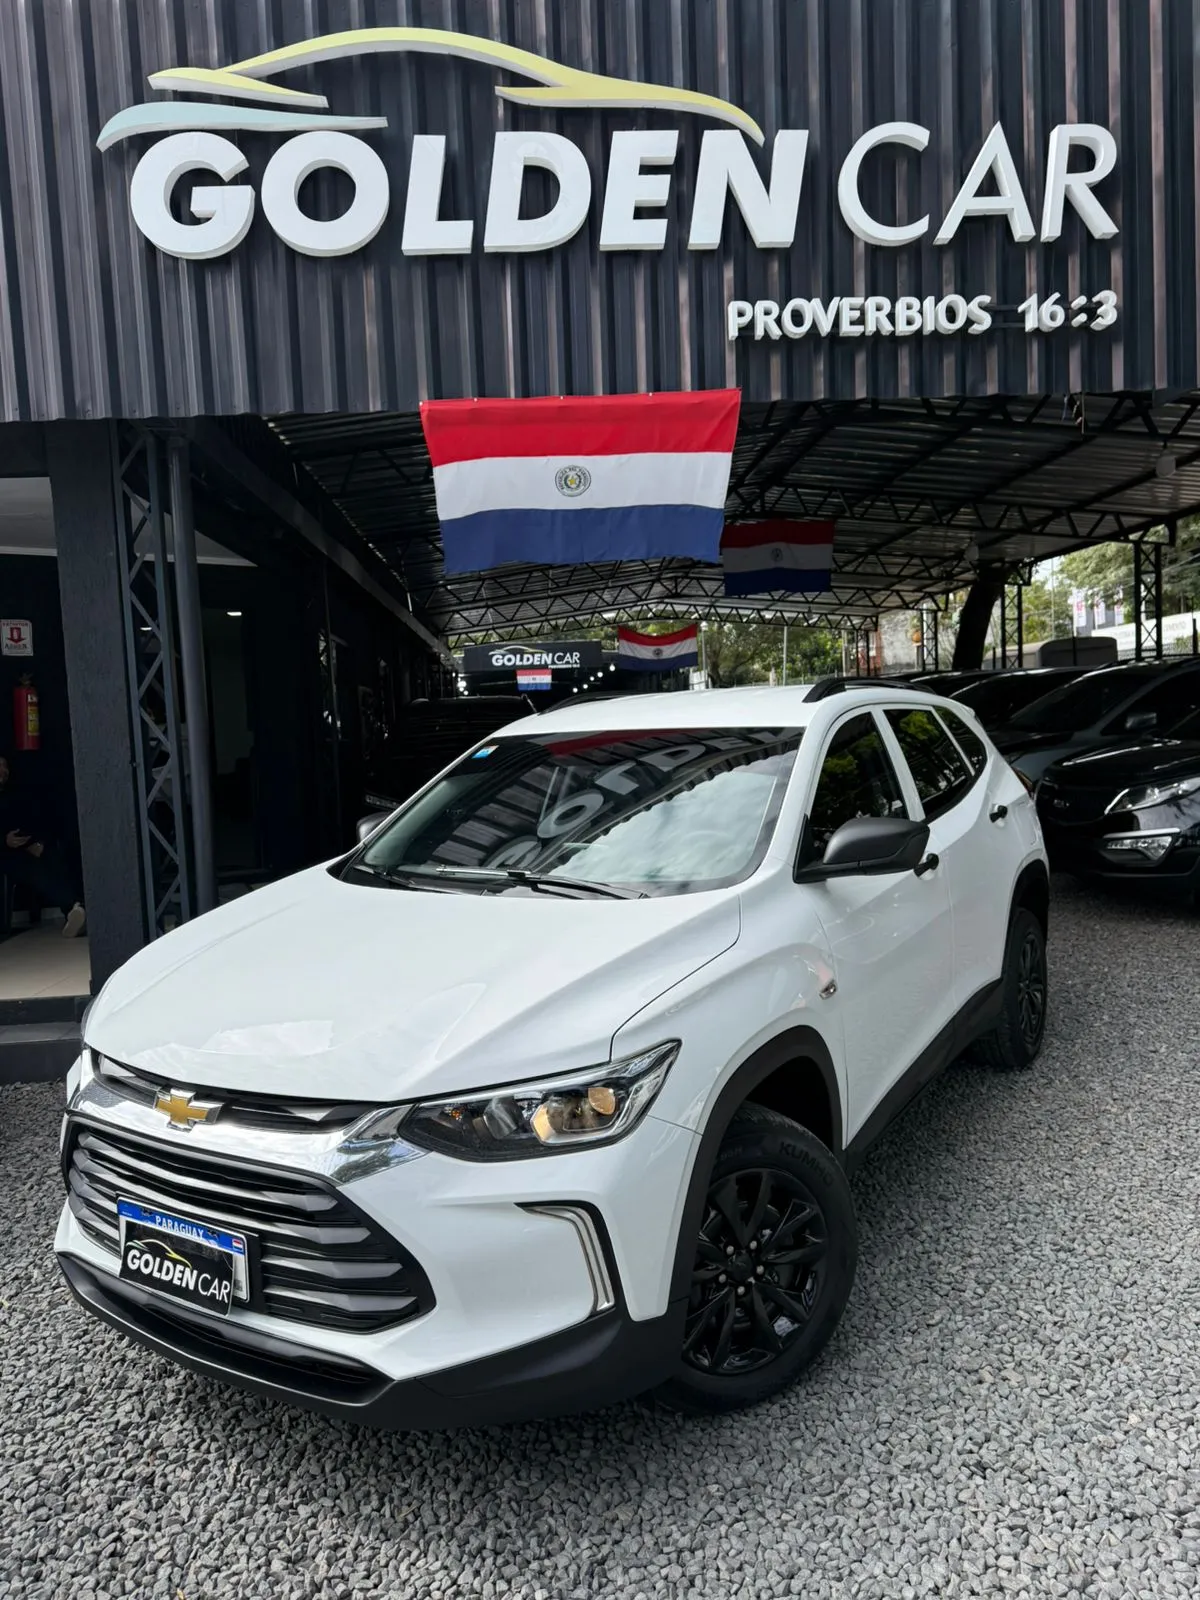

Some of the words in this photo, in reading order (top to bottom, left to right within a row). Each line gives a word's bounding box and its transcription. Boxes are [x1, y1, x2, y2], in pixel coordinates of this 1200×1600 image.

[129, 129, 809, 259] GOLDEN
[837, 121, 1119, 246] CAR
[727, 294, 992, 340] PROVERBIOS
[491, 653, 552, 666] GOLDEN
[553, 652, 580, 665] CAR
[779, 1141, 835, 1187] KUMHO
[155, 1215, 204, 1239] PARAGUAY
[127, 1249, 198, 1290] GOLDEN
[198, 1273, 231, 1303] CAR
